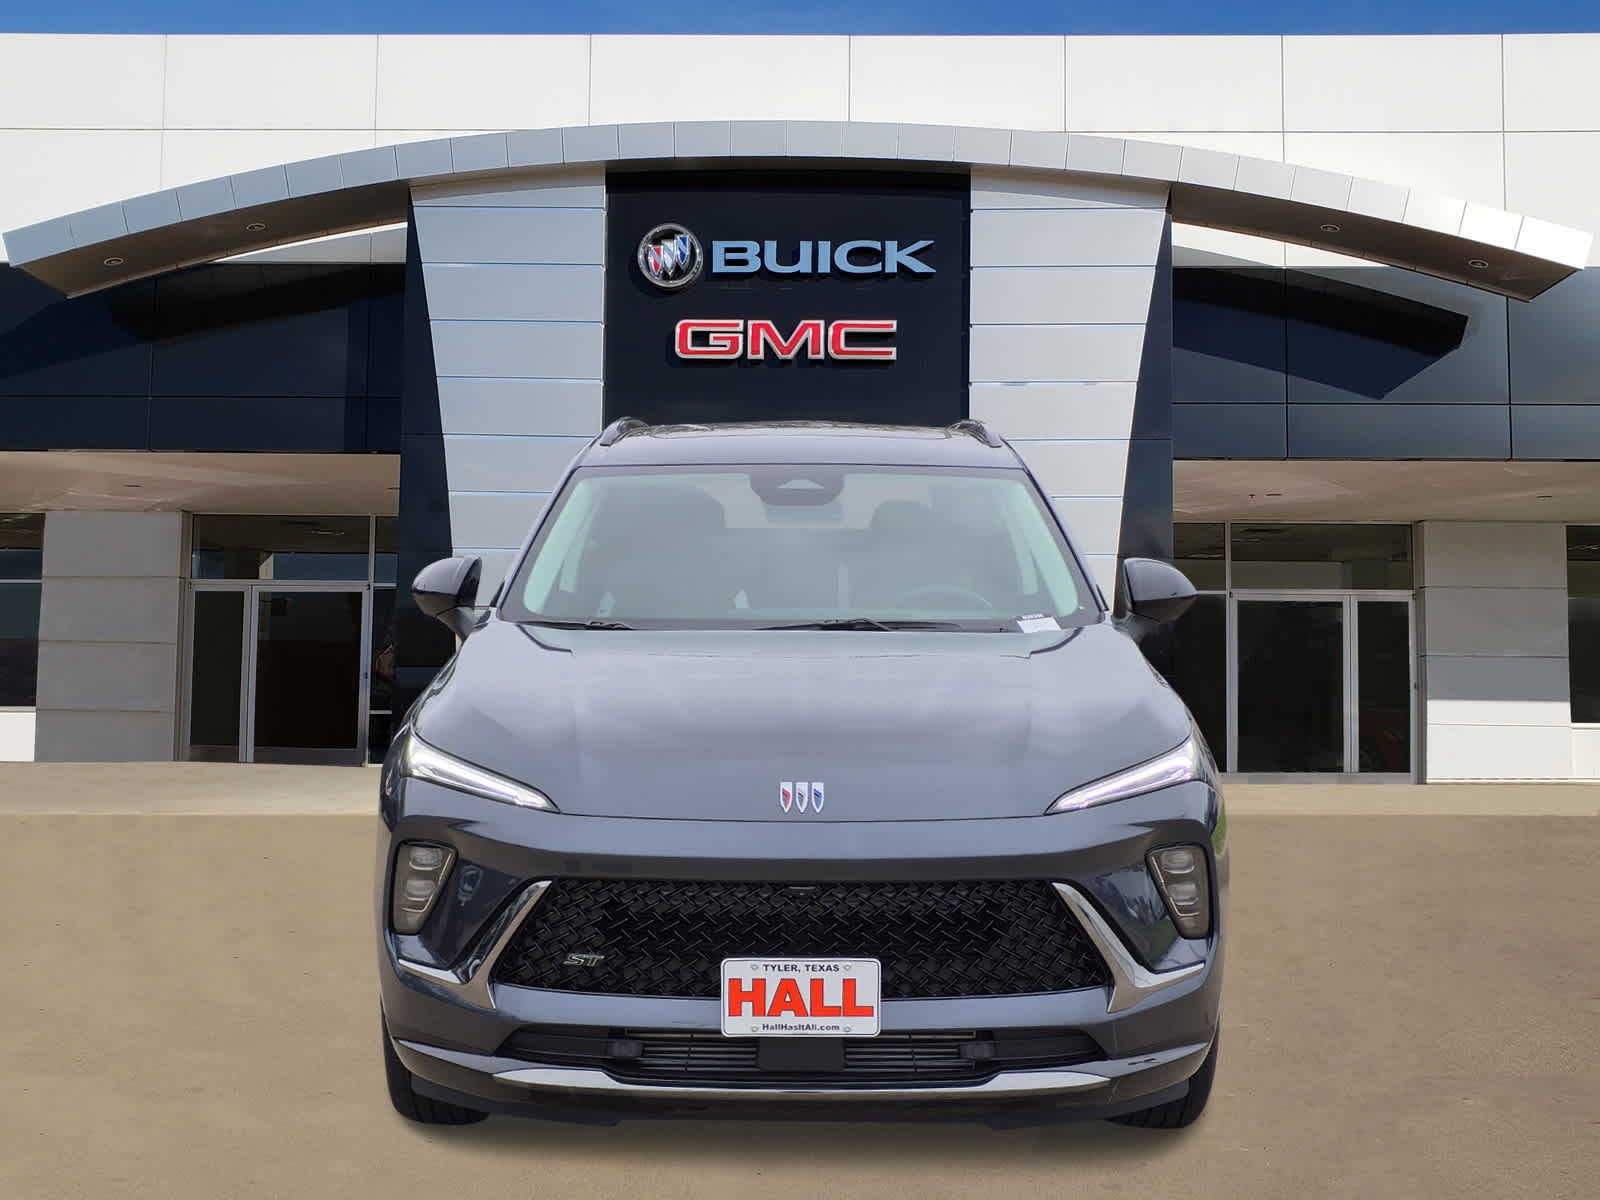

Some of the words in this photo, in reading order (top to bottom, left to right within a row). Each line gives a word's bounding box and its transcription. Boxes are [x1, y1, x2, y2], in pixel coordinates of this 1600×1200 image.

[712, 240, 936, 273] BUICK
[675, 319, 897, 360] GMC
[763, 964, 801, 973] TYLER,
[805, 964, 840, 972] TEXAS
[728, 978, 874, 1017] HALL
